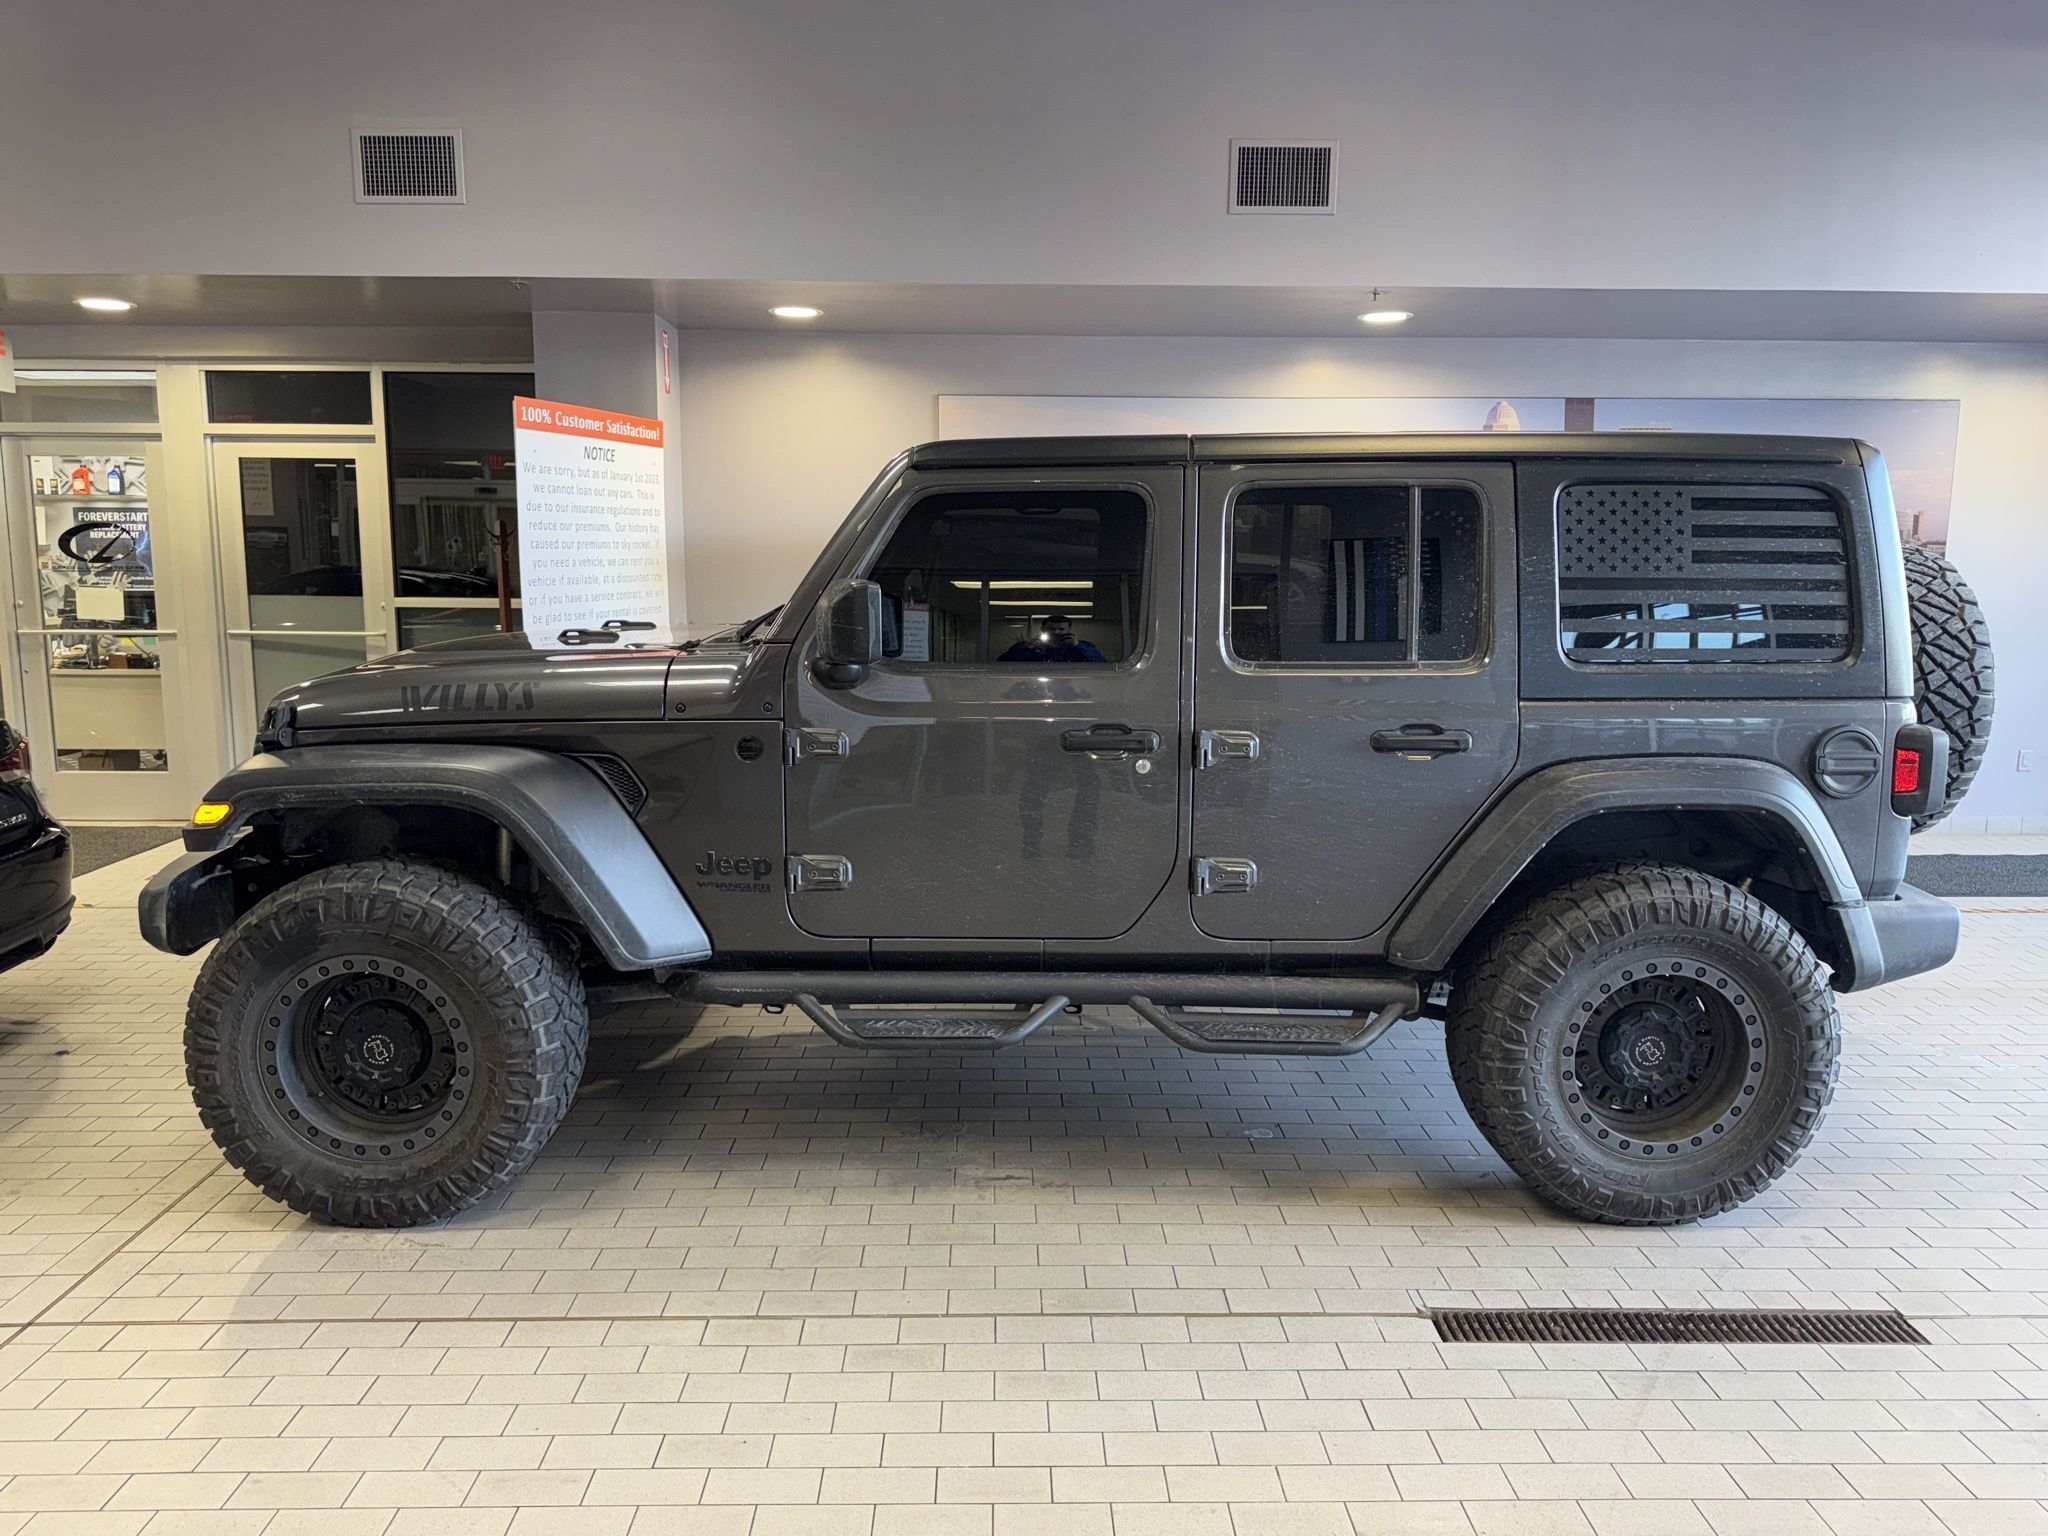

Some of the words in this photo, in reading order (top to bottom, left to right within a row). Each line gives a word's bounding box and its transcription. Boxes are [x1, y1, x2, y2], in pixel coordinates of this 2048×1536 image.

[521, 405, 552, 425] 100%
[555, 410, 604, 432] Customer
[606, 419, 660, 440] Satisfaction!
[583, 445, 615, 462] NOTICE
[522, 461, 537, 473] We
[538, 465, 552, 475] are
[554, 466, 576, 479] sorry,
[578, 465, 590, 478] but
[592, 470, 600, 479] as
[601, 469, 609, 480] of
[609, 470, 634, 483] January
[634, 472, 644, 483] 1st
[533, 484, 545, 493] we
[547, 484, 575, 495] cannot
[576, 484, 592, 496] loan
[594, 487, 606, 497] out
[607, 489, 618, 500] any
[619, 489, 633, 499] cars.
[637, 489, 649, 500] This
[650, 491, 655, 500] is
[78, 511, 149, 522] FOREVERSTART
[526, 500, 542, 512] due
[544, 502, 553, 512] to
[555, 503, 569, 513] our
[571, 502, 605, 514] insurance
[606, 505, 641, 517] regulations
[642, 507, 653, 517] and
[654, 508, 660, 517] to
[528, 519, 557, 531] reduce
[559, 522, 573, 531] our
[575, 521, 611, 533] premiums.
[615, 521, 627, 533] Our
[628, 522, 649, 535] history
[650, 523, 660, 533] has
[530, 539, 559, 549] caused
[561, 540, 574, 549] our
[576, 538, 611, 552] premiums
[612, 540, 619, 549] to
[620, 539, 631, 551] sky
[532, 559, 548, 572] you
[550, 557, 570, 568] need
[572, 559, 577, 567] a
[579, 556, 606, 569] vehicle,
[607, 558, 617, 567] we
[618, 558, 629, 566] can
[630, 557, 643, 566] rent
[528, 576, 557, 587] vehicle
[559, 574, 565, 585] if
[566, 573, 600, 586] available,
[602, 575, 610, 584] at
[611, 576, 615, 584] a
[616, 573, 650, 583] discounted
[528, 596, 537, 606] or
[540, 593, 546, 604] if
[548, 595, 563, 606] you
[565, 593, 583, 604] have
[585, 593, 589, 602] a
[591, 591, 615, 602] service
[644, 590, 655, 599] we
[532, 612, 543, 624] be
[545, 612, 562, 625] glad
[564, 611, 571, 621] to
[574, 611, 586, 620] see
[589, 609, 594, 620] if
[595, 609, 612, 621] your
[612, 606, 631, 617] rental
[633, 606, 638, 615] is
[401, 681, 541, 711] WILLYS
[695, 850, 772, 880] Jeep
[696, 881, 771, 890] WRANGLER
